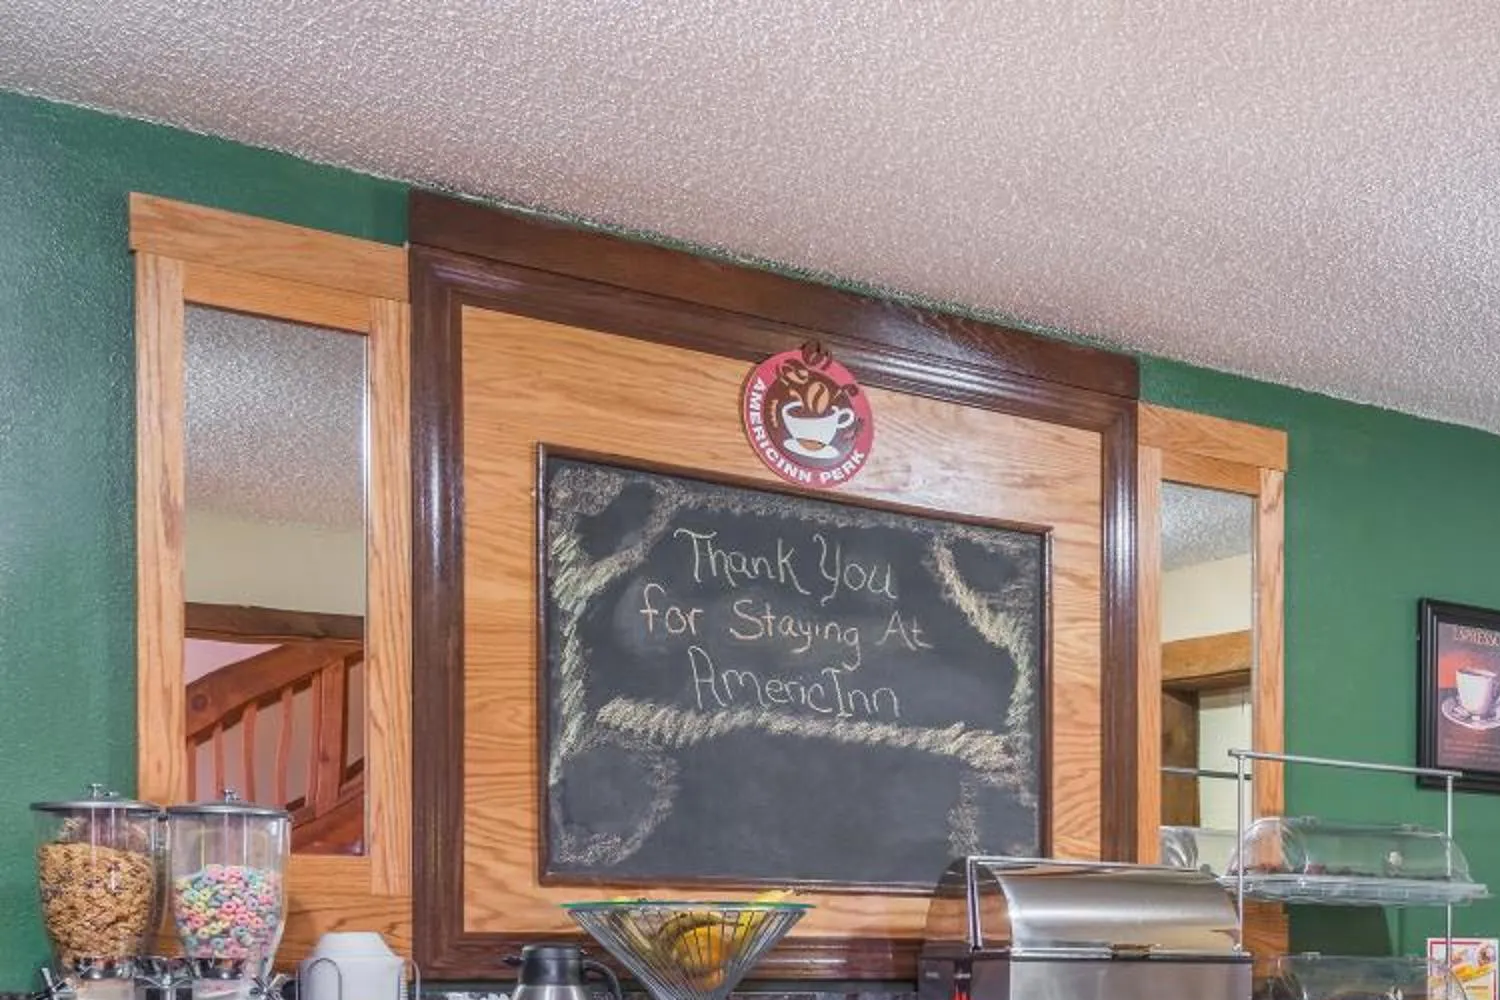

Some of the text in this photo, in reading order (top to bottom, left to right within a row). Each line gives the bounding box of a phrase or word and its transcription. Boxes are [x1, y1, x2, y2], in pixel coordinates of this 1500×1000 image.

[749, 376, 866, 485] AMERICINN PERK
[672, 527, 898, 607] Thank You
[639, 582, 935, 672] for Staying At
[686, 644, 901, 720] AmericInn
